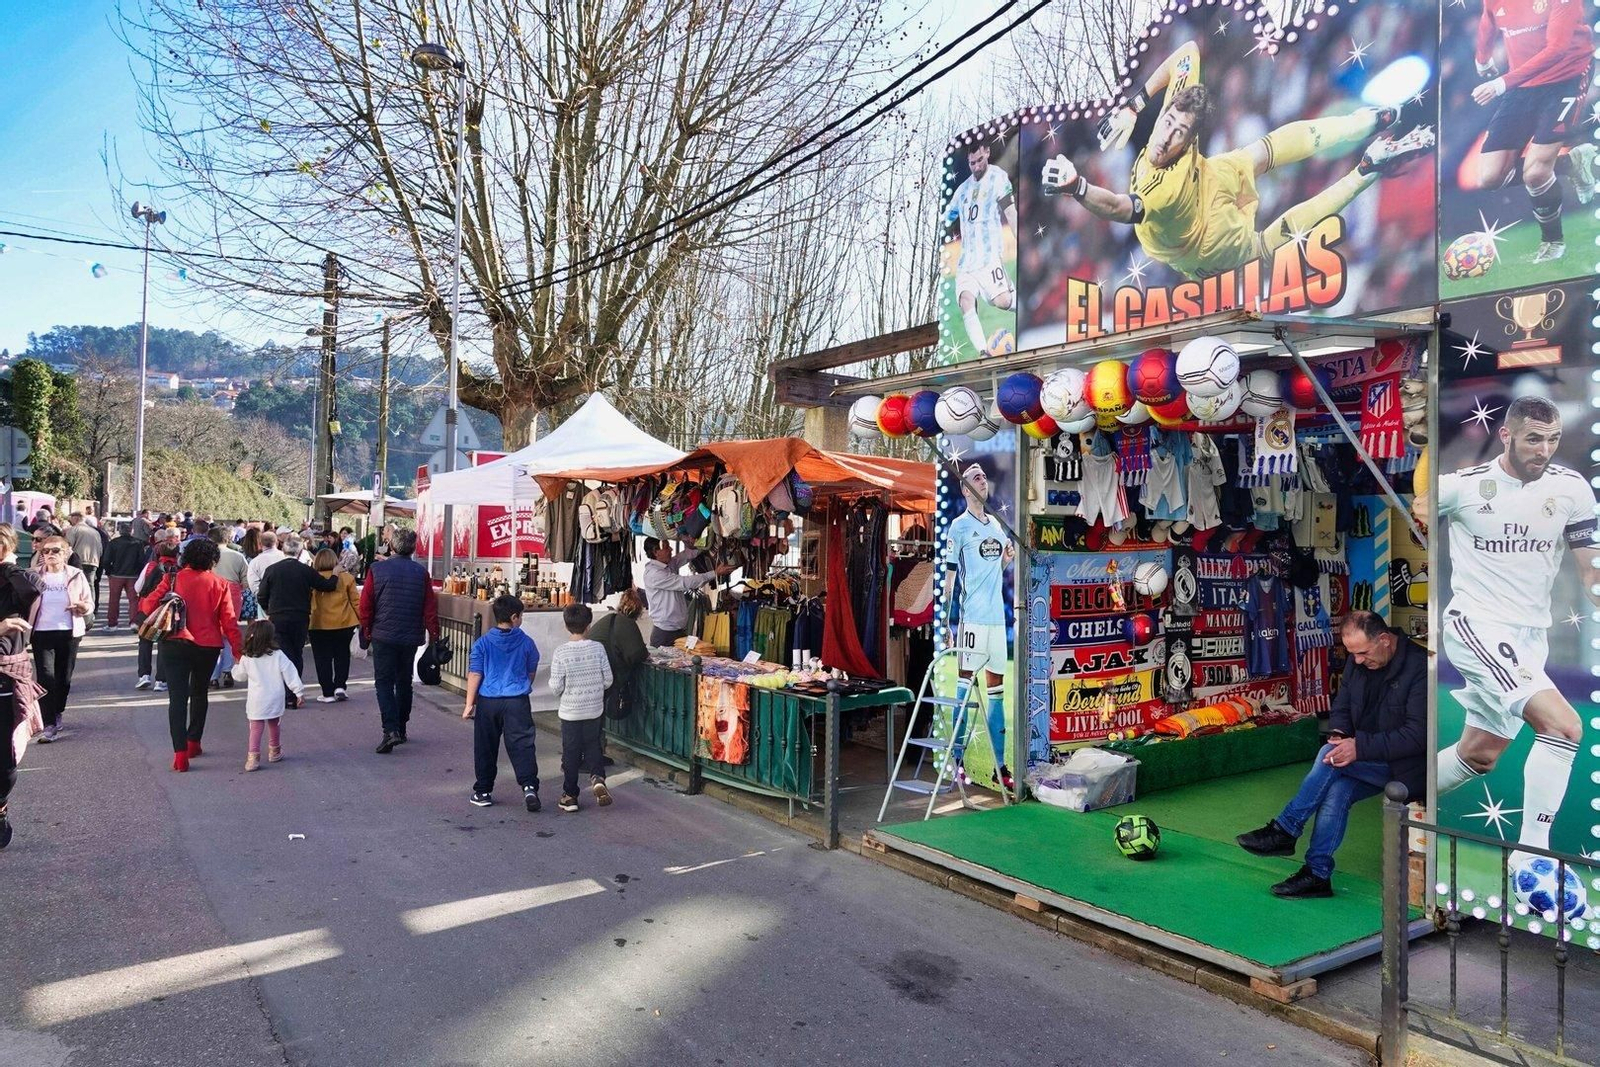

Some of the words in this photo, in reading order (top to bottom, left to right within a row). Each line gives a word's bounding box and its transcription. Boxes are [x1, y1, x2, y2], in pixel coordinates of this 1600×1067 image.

[1557, 97, 1576, 122] 7
[967, 204, 979, 222] 10
[991, 267, 1004, 284] 10
[1066, 277, 1104, 342] EL
[1113, 213, 1347, 334] CASILLAS
[1503, 523, 1530, 537] Fly
[1568, 528, 1593, 540] RESPEC
[1473, 535, 1553, 553] Emirates
[1196, 557, 1232, 579] ALLEZ
[1061, 585, 1144, 611] BELGIUE
[1068, 619, 1123, 639] CHELS
[1298, 620, 1330, 631] GALICIA
[964, 630, 975, 649] 10
[1032, 596, 1050, 721] CELTA
[1057, 648, 1148, 675] AJAX
[1498, 642, 1518, 667] 9
[1063, 688, 1141, 711] Dortund
